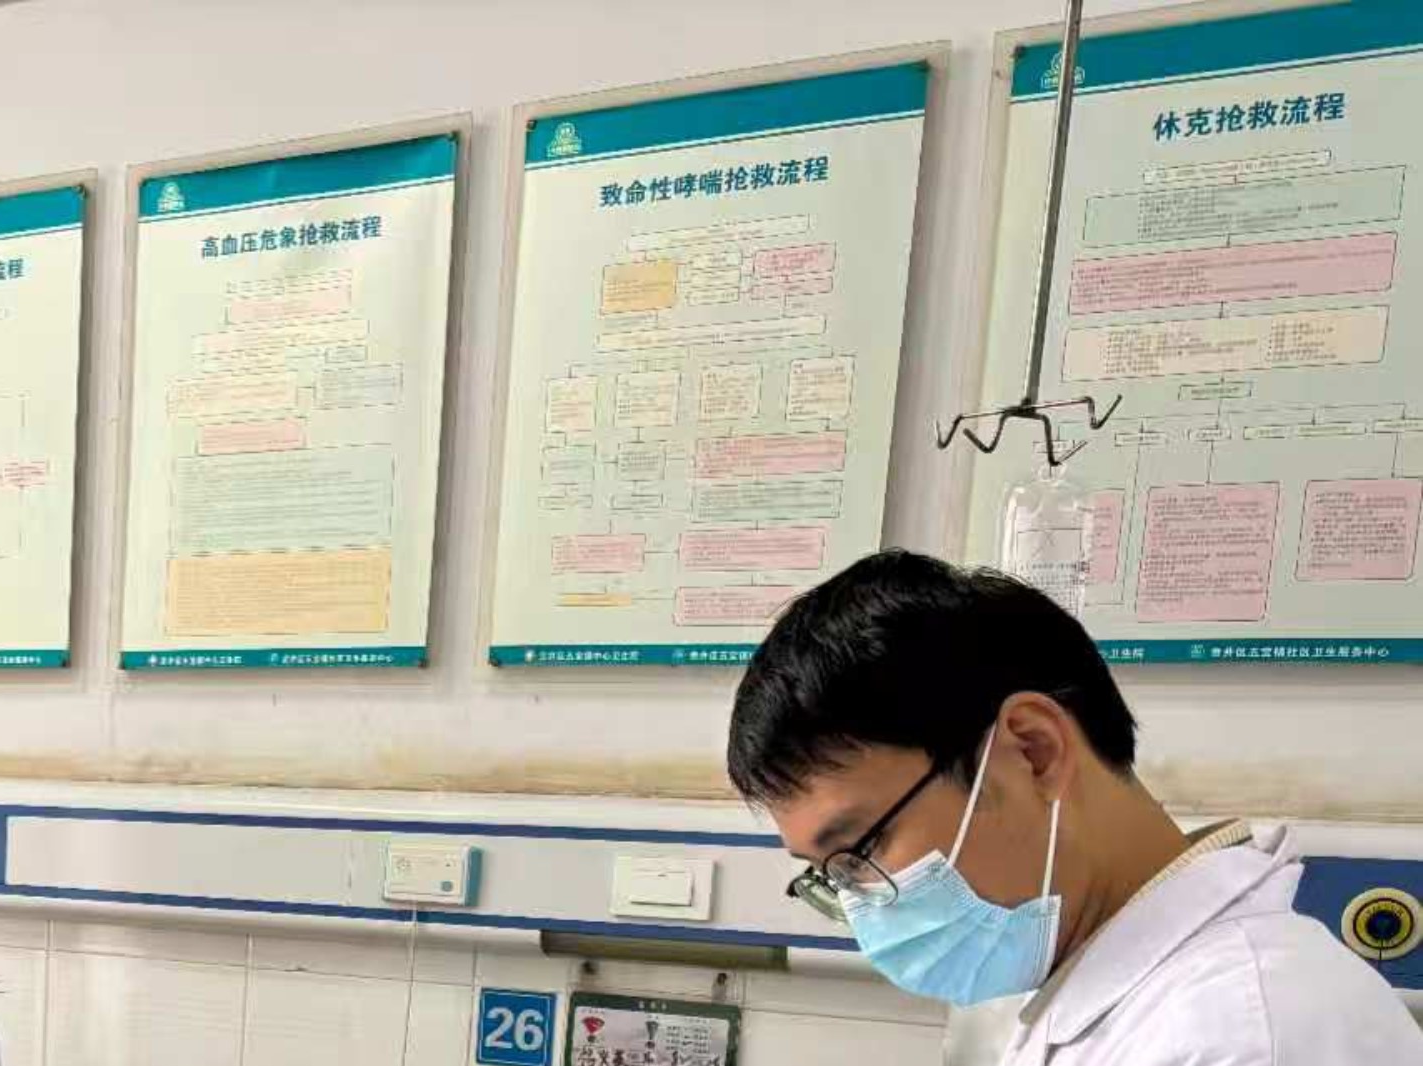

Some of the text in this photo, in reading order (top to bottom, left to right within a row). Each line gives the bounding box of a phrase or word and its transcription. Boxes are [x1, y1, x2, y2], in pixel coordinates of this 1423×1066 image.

[1153, 93, 1345, 141] 休克抢救流程
[599, 156, 829, 207] 致命性哮喘抢救流程
[202, 216, 382, 258] 高血压危象抢救流程
[485, 1007, 544, 1051] 26
